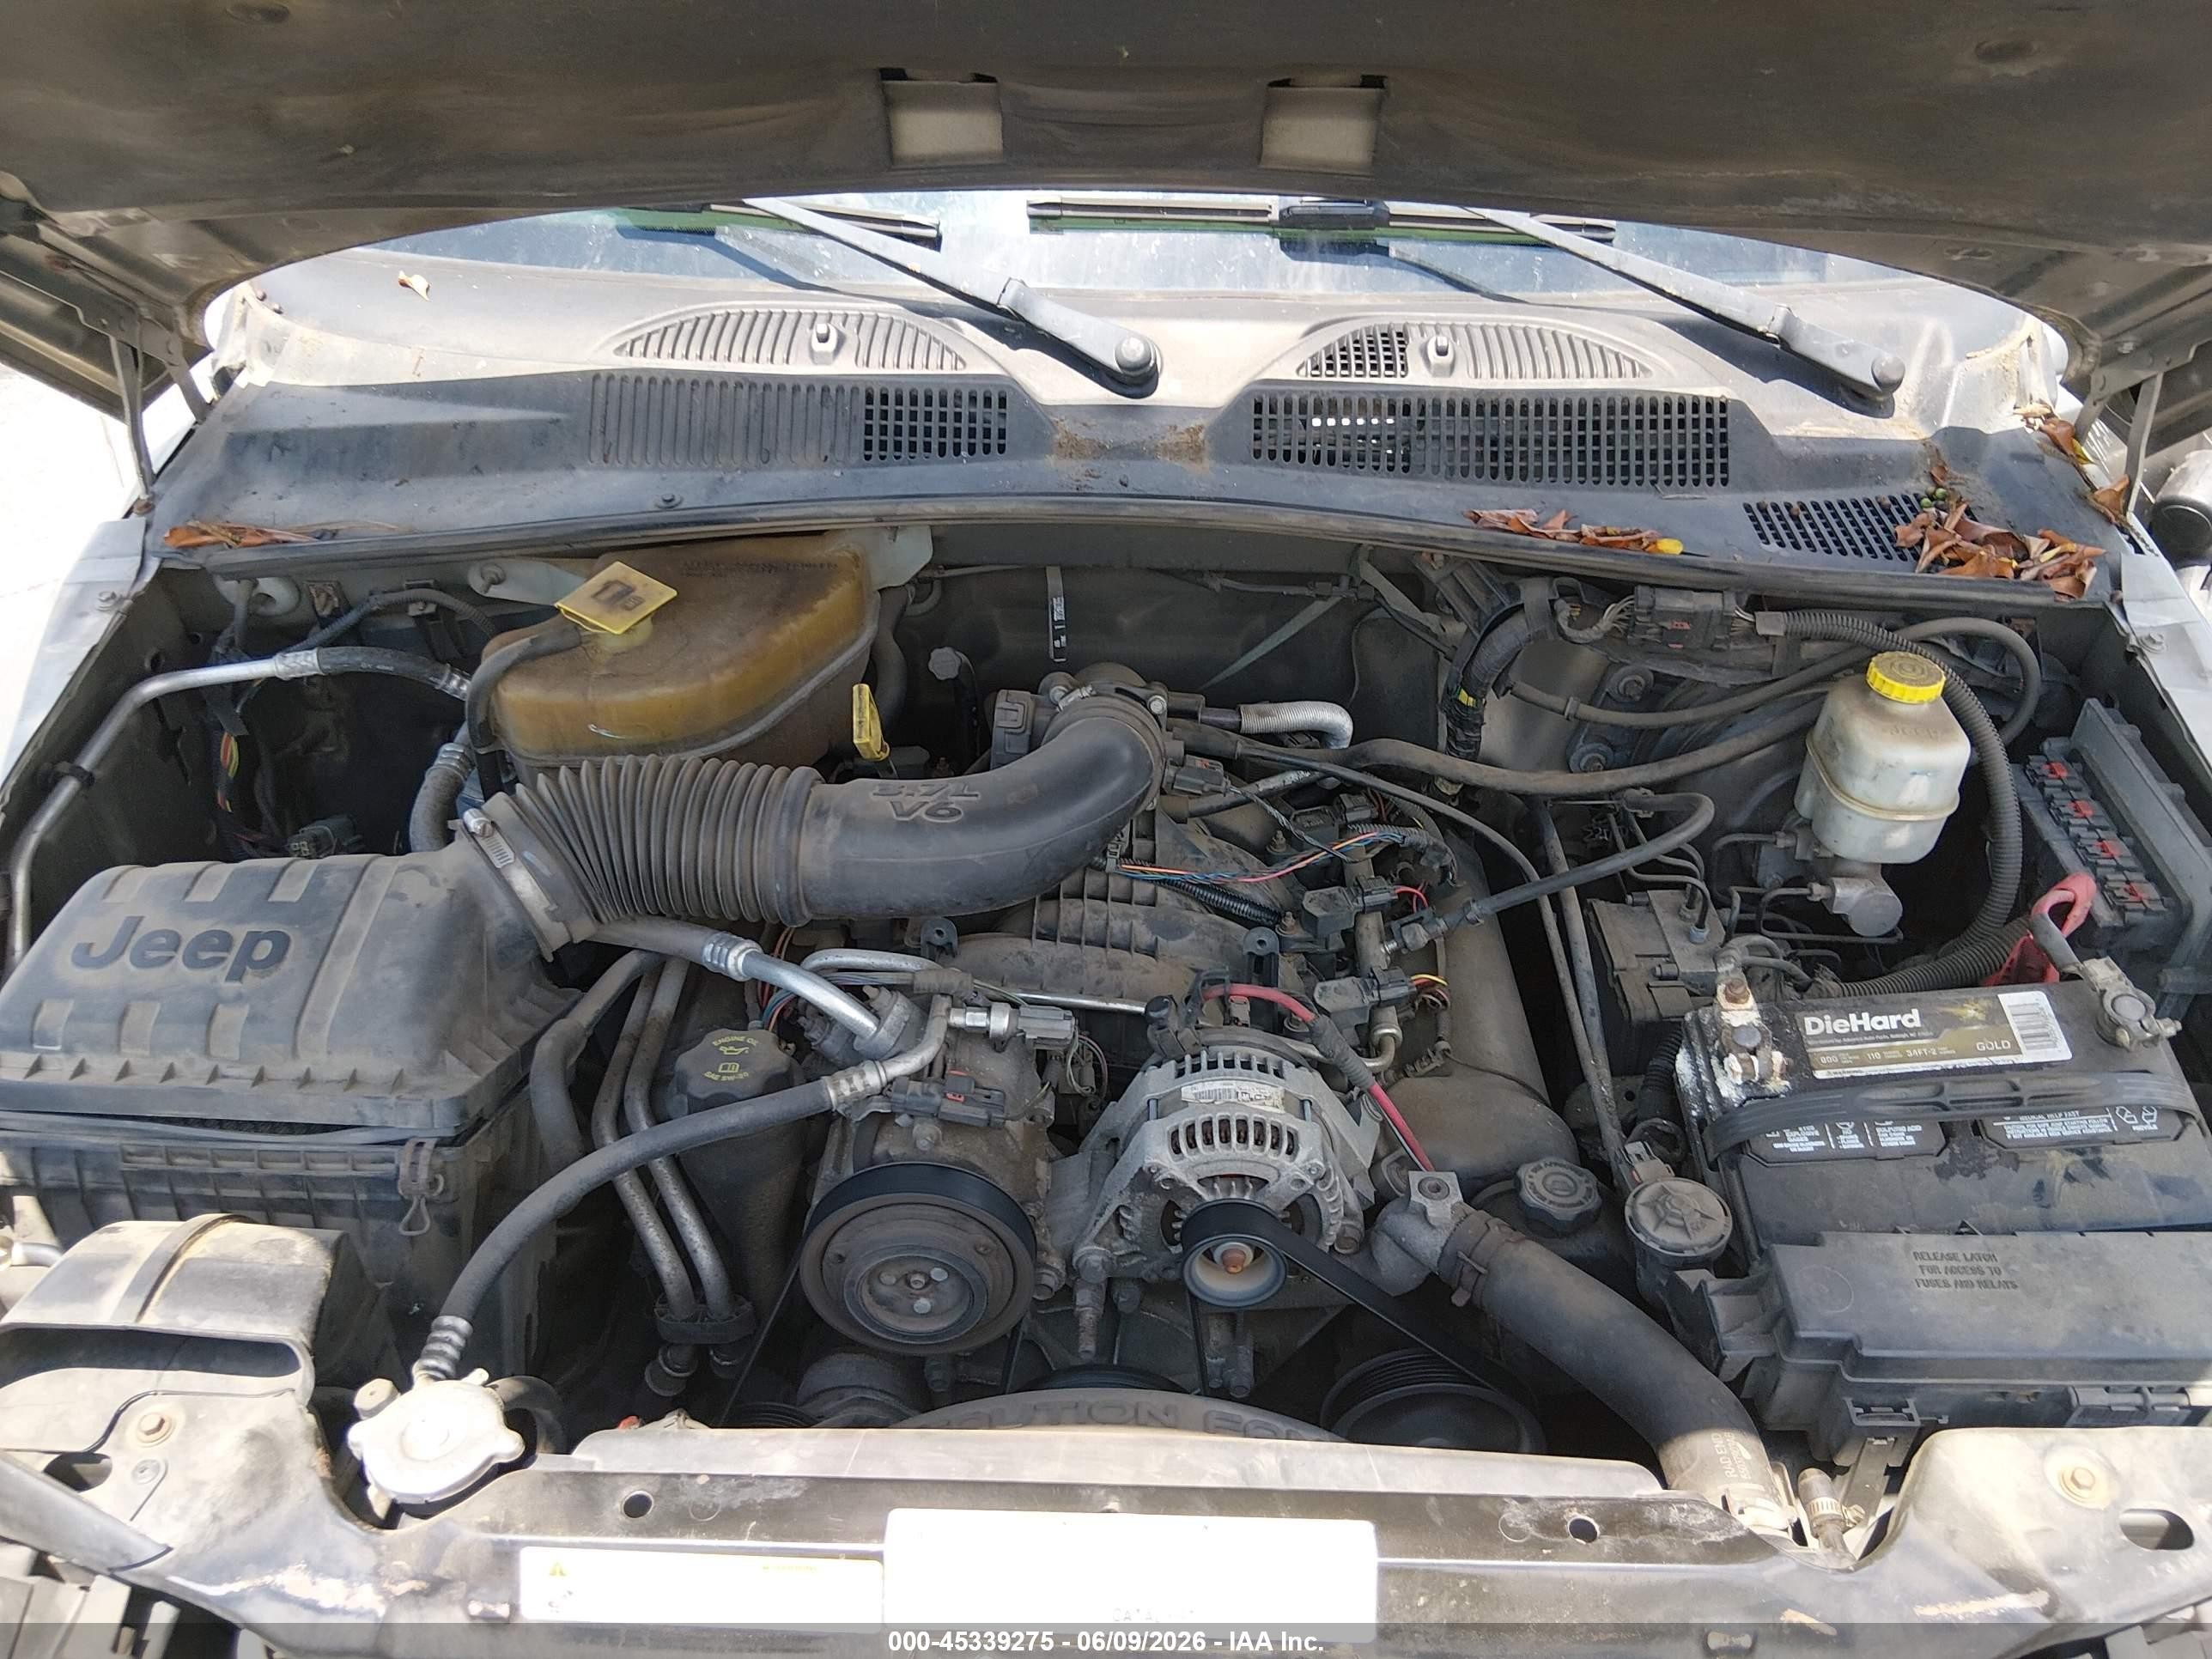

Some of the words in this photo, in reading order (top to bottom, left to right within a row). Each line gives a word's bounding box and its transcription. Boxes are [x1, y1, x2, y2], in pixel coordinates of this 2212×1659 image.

[889, 799, 964, 823] V6
[70, 915, 292, 983] Jeep
[1803, 1008, 1922, 1036] DieHard
[712, 1036, 745, 1046] ENGINE
[1976, 1039, 2012, 1052] GOLD
[704, 1071, 721, 1080] SAE
[1912, 1251, 1960, 1261] RELEASE
[1962, 1252, 1998, 1262] LATCH
[1918, 1264, 1942, 1275] FOR
[1944, 1265, 1985, 1275] ACCESS
[1986, 1266, 2002, 1275] TO
[1915, 1278, 1951, 1288] FUSES
[1954, 1279, 1975, 1289] AND
[1977, 1279, 2019, 1290] RELAYS
[1711, 1431, 1727, 1455] END
[1718, 1455, 1738, 1478] RAD
